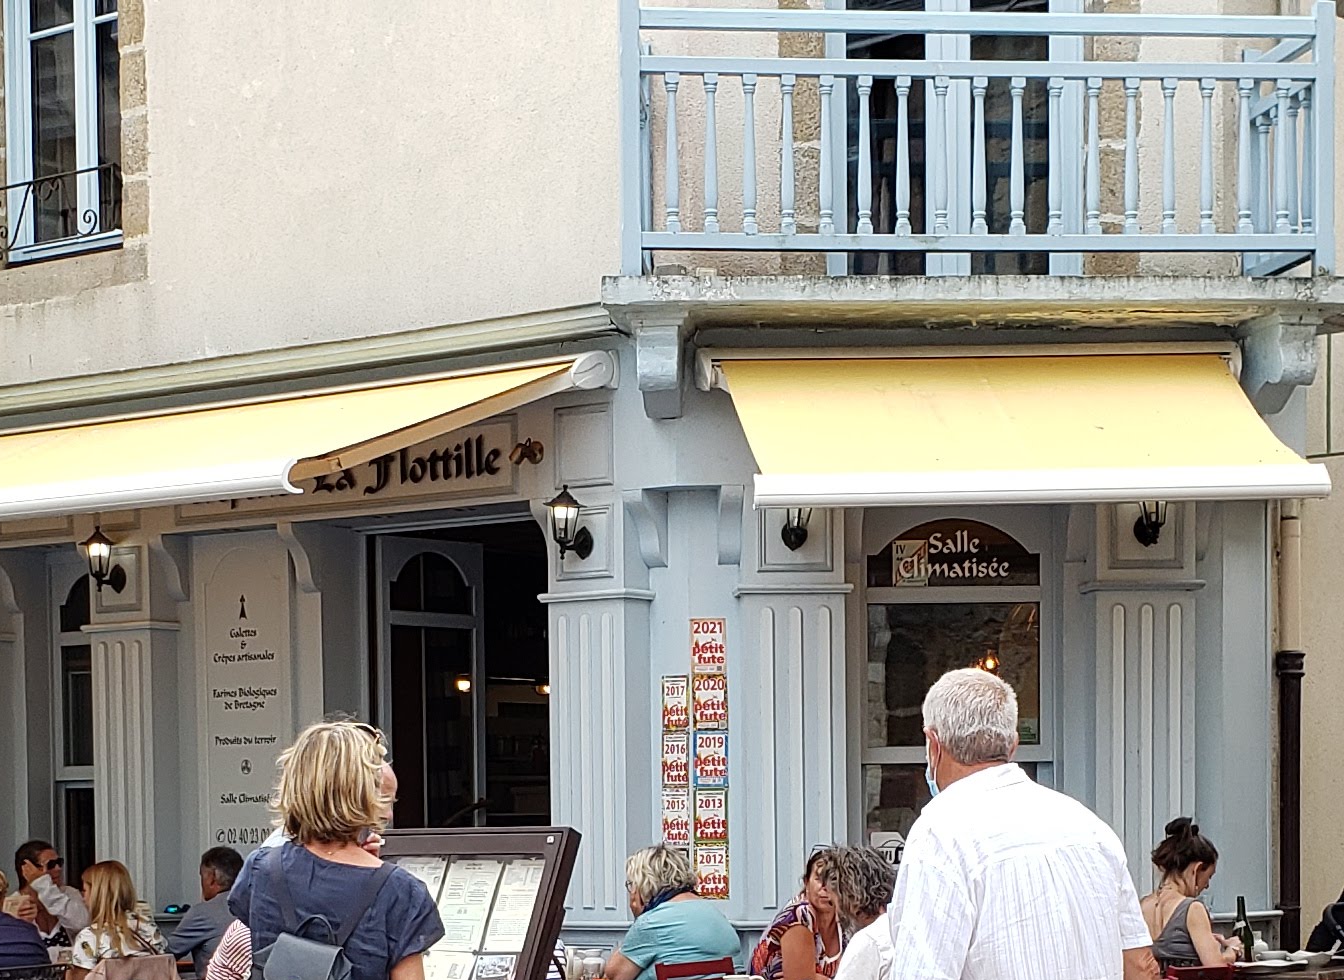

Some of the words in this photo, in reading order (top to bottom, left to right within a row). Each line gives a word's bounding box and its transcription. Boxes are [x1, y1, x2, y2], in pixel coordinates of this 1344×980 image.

[929, 530, 980, 554] Salle
[898, 558, 1010, 579] Climatisée
[693, 621, 723, 634] 2021
[692, 640, 725, 657] petit
[237, 649, 275, 662] artisanales
[665, 686, 685, 696] 2017
[695, 679, 725, 691] 2020
[664, 743, 686, 755] 2016
[698, 736, 724, 749] 2019
[666, 799, 685, 810] 2015
[698, 798, 723, 809] 2013
[227, 828, 237, 844] 02
[238, 827, 249, 844] 40
[699, 853, 724, 865] 2012
